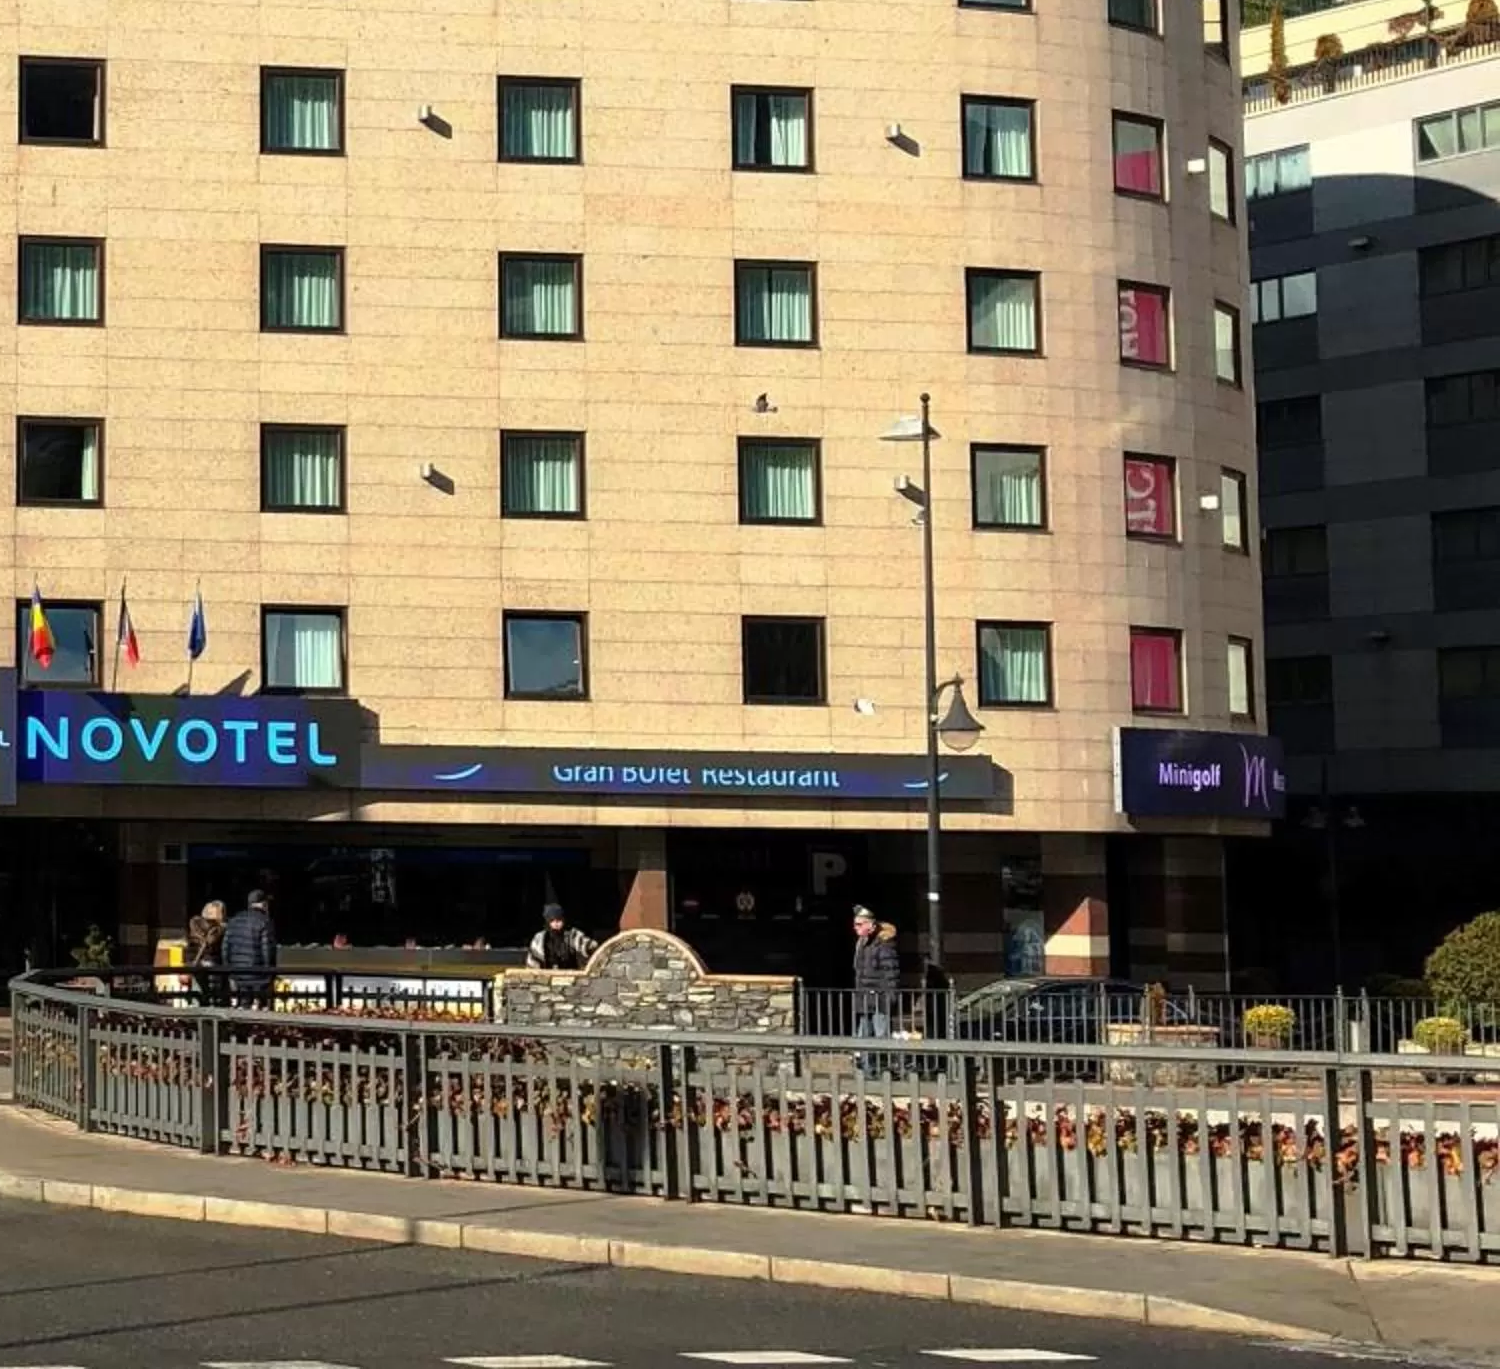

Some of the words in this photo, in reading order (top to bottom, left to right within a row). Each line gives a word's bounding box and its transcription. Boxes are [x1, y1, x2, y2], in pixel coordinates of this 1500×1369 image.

[26, 716, 337, 765] NOVOTEL
[553, 764, 614, 783] Gran
[702, 766, 840, 788] Restaurant
[1159, 762, 1221, 792] Minigolf
